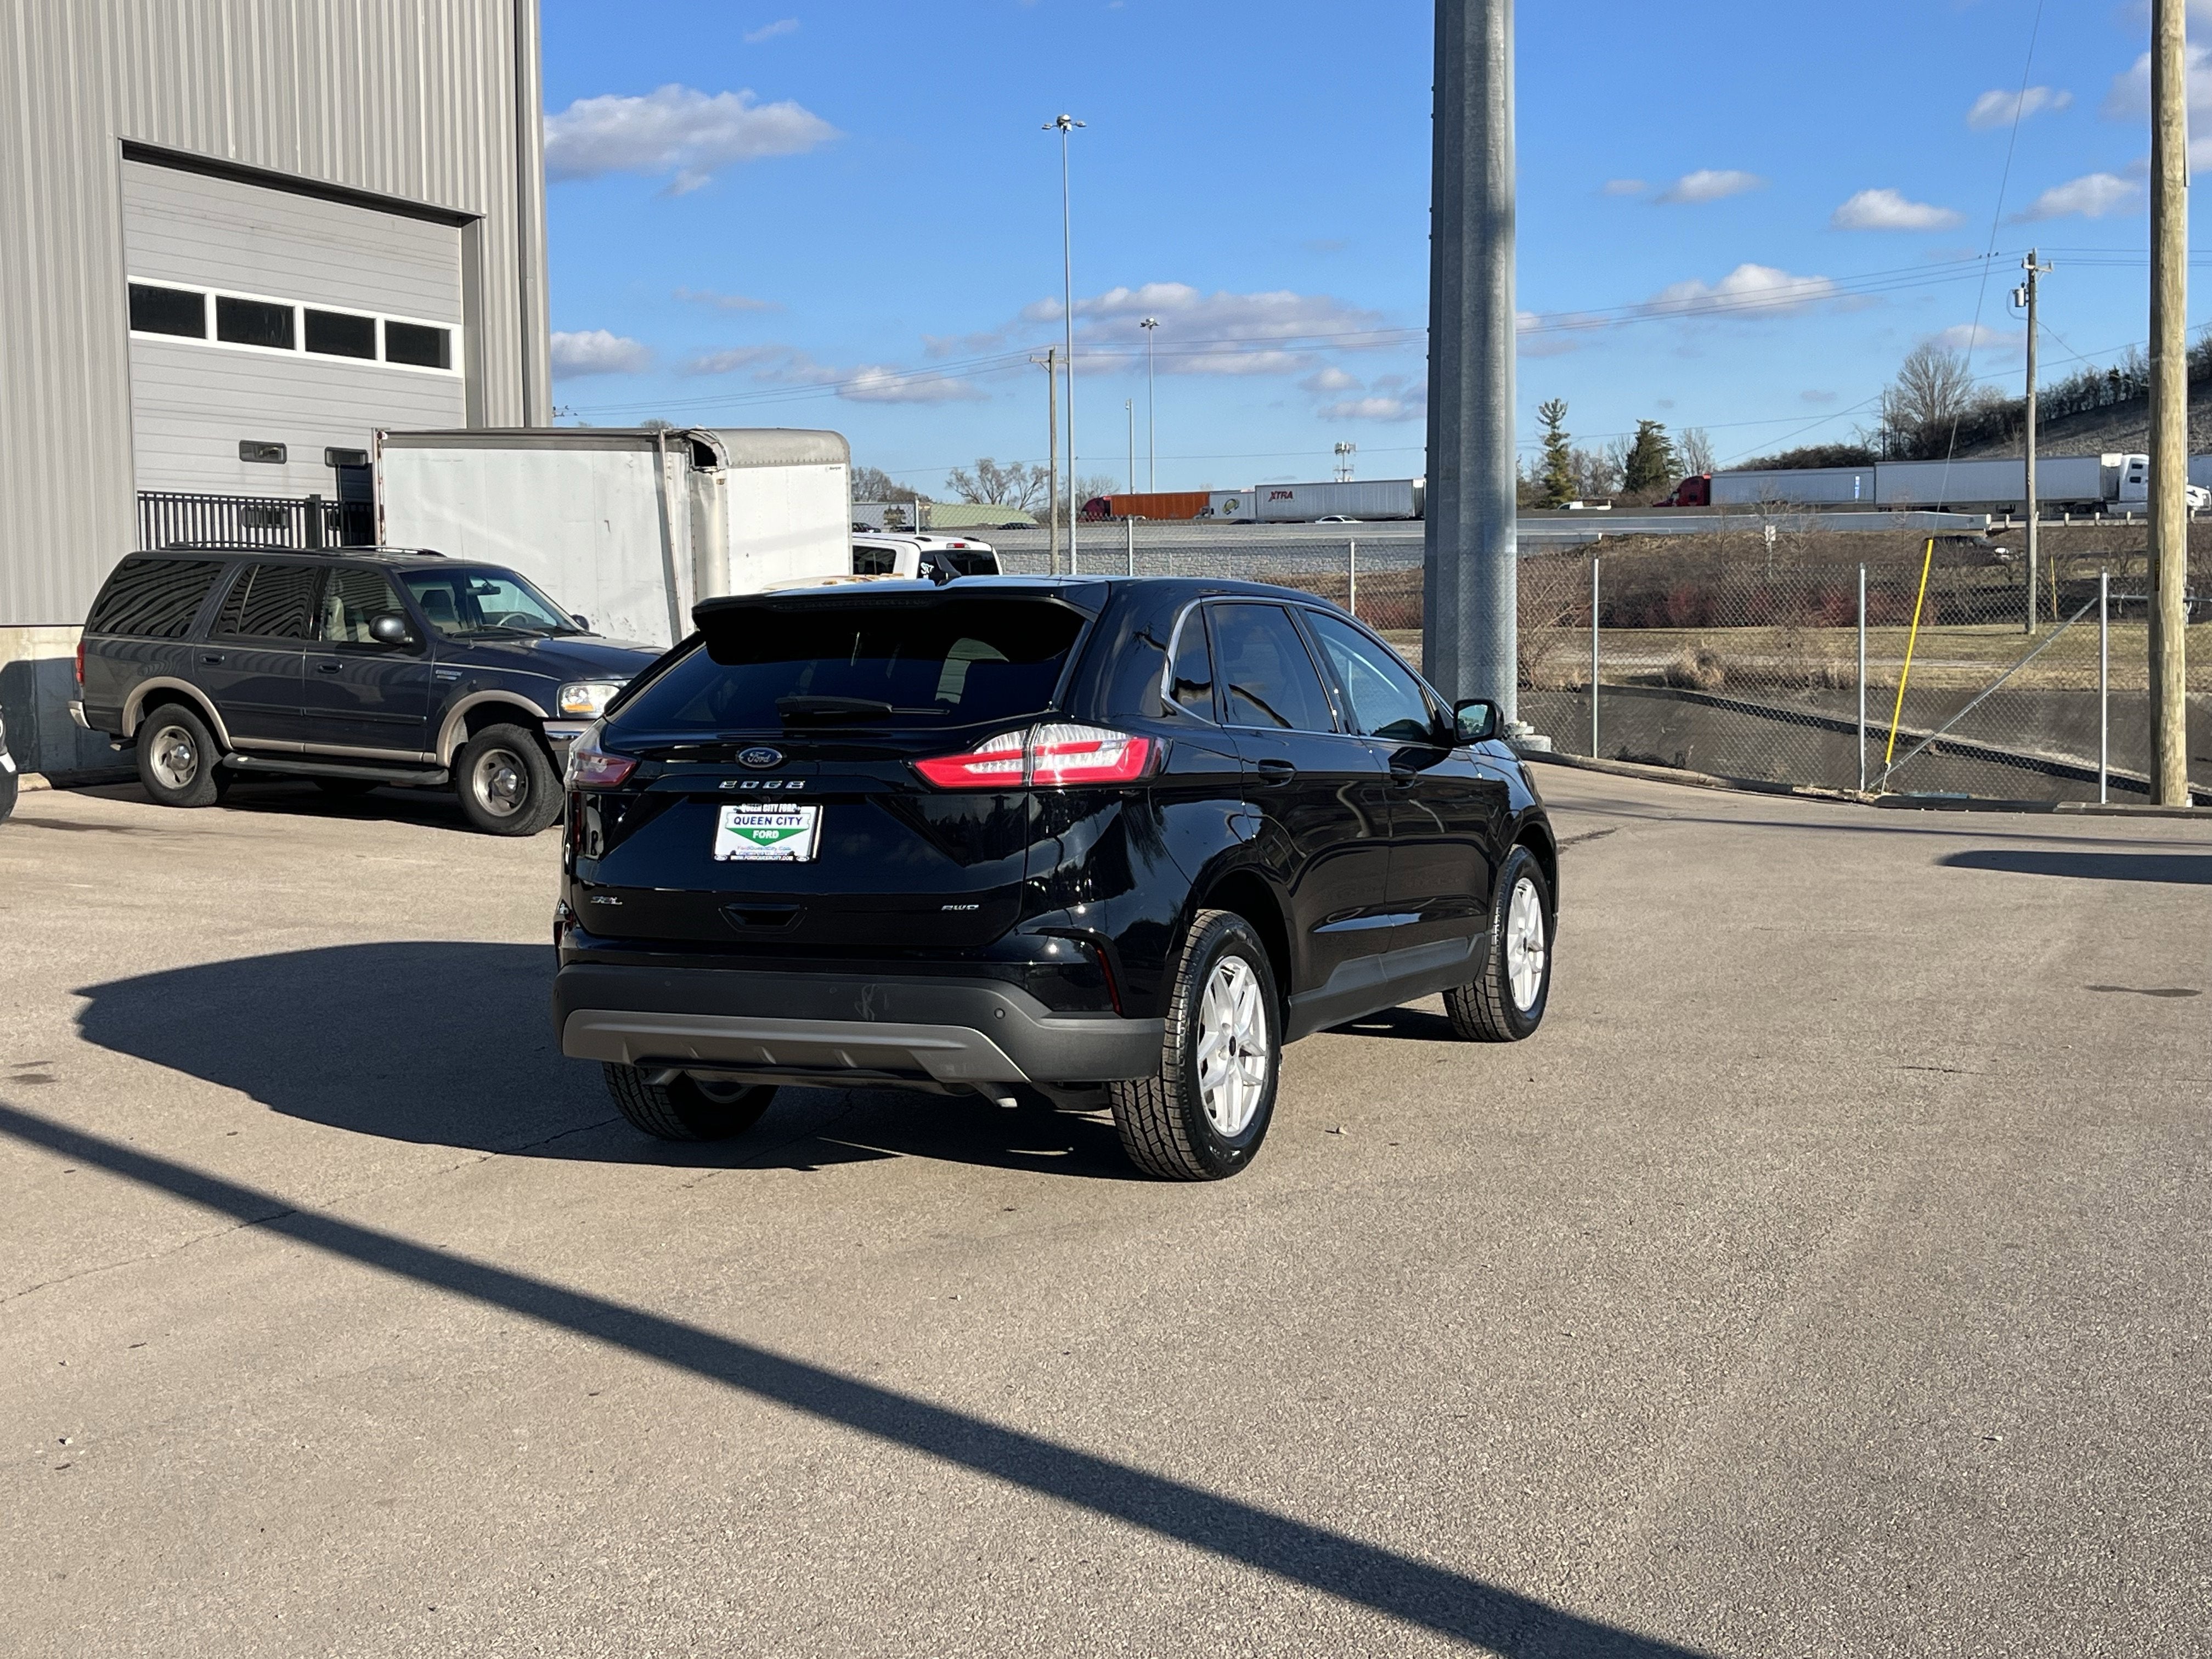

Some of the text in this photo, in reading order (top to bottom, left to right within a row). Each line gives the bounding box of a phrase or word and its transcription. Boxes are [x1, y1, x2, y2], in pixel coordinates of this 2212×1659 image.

[1268, 491, 1293, 501] XTRA
[747, 752, 771, 763] Ford
[763, 804, 778, 812] CITY
[733, 816, 802, 825] QUEEN CITY
[753, 830, 779, 838] FORD
